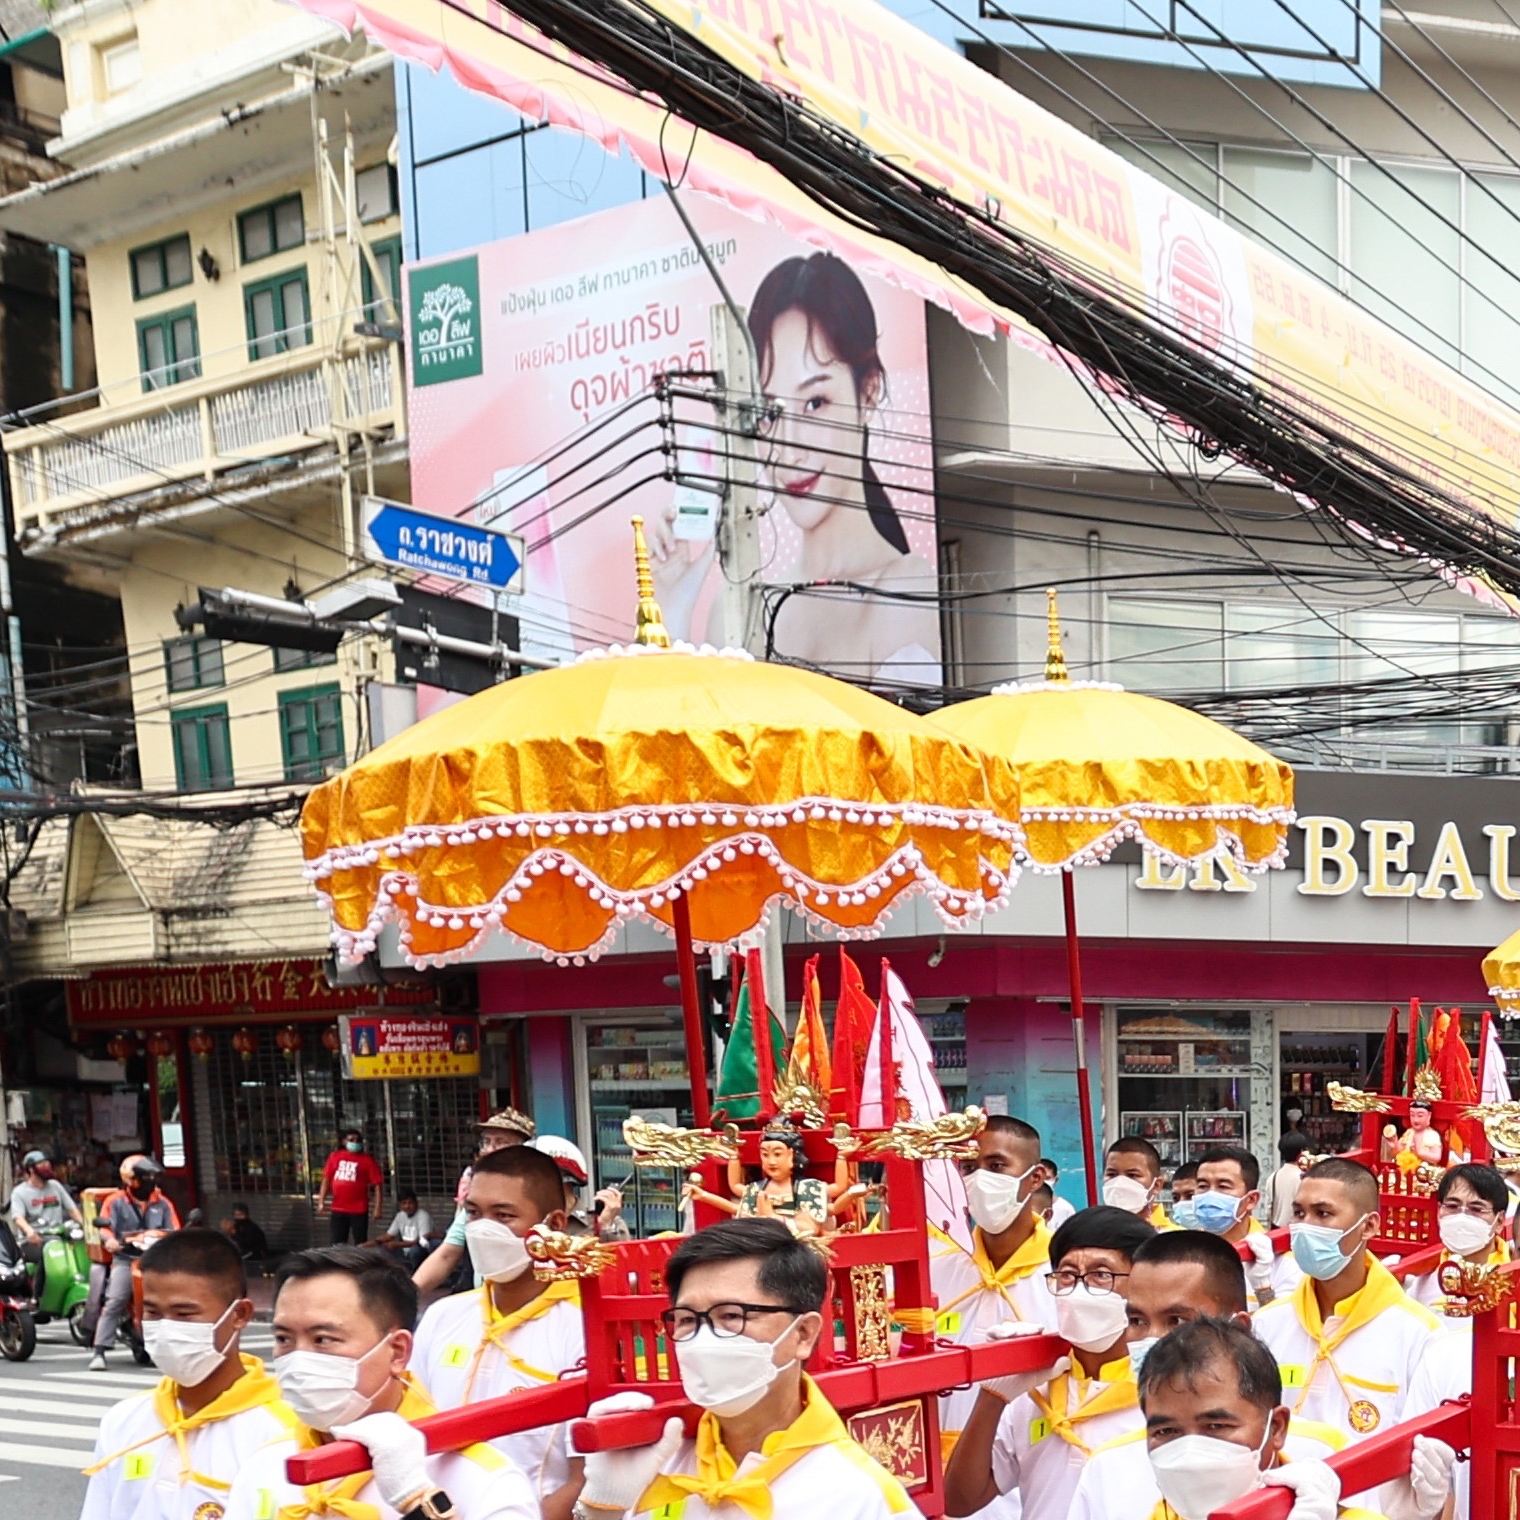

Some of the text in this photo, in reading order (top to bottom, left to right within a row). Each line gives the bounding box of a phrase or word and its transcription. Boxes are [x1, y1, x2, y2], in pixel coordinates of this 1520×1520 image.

[501, 285, 546, 317] แป้งฝุ่น
[550, 284, 575, 305] เดอ
[578, 272, 600, 299] ลีฟ
[603, 261, 658, 291] ทานาคา
[419, 329, 439, 347] เดอ
[514, 301, 680, 373] เผยผิวเนียนกริบ
[421, 345, 474, 367] ทานาคา
[570, 339, 714, 421] ดุจผ้าซาติ
[399, 525, 495, 567] ถ.ราชวงศ์
[398, 547, 468, 579] Ratchawong
[334, 1170, 358, 1183] PACK
[337, 1159, 359, 1172] SIX
